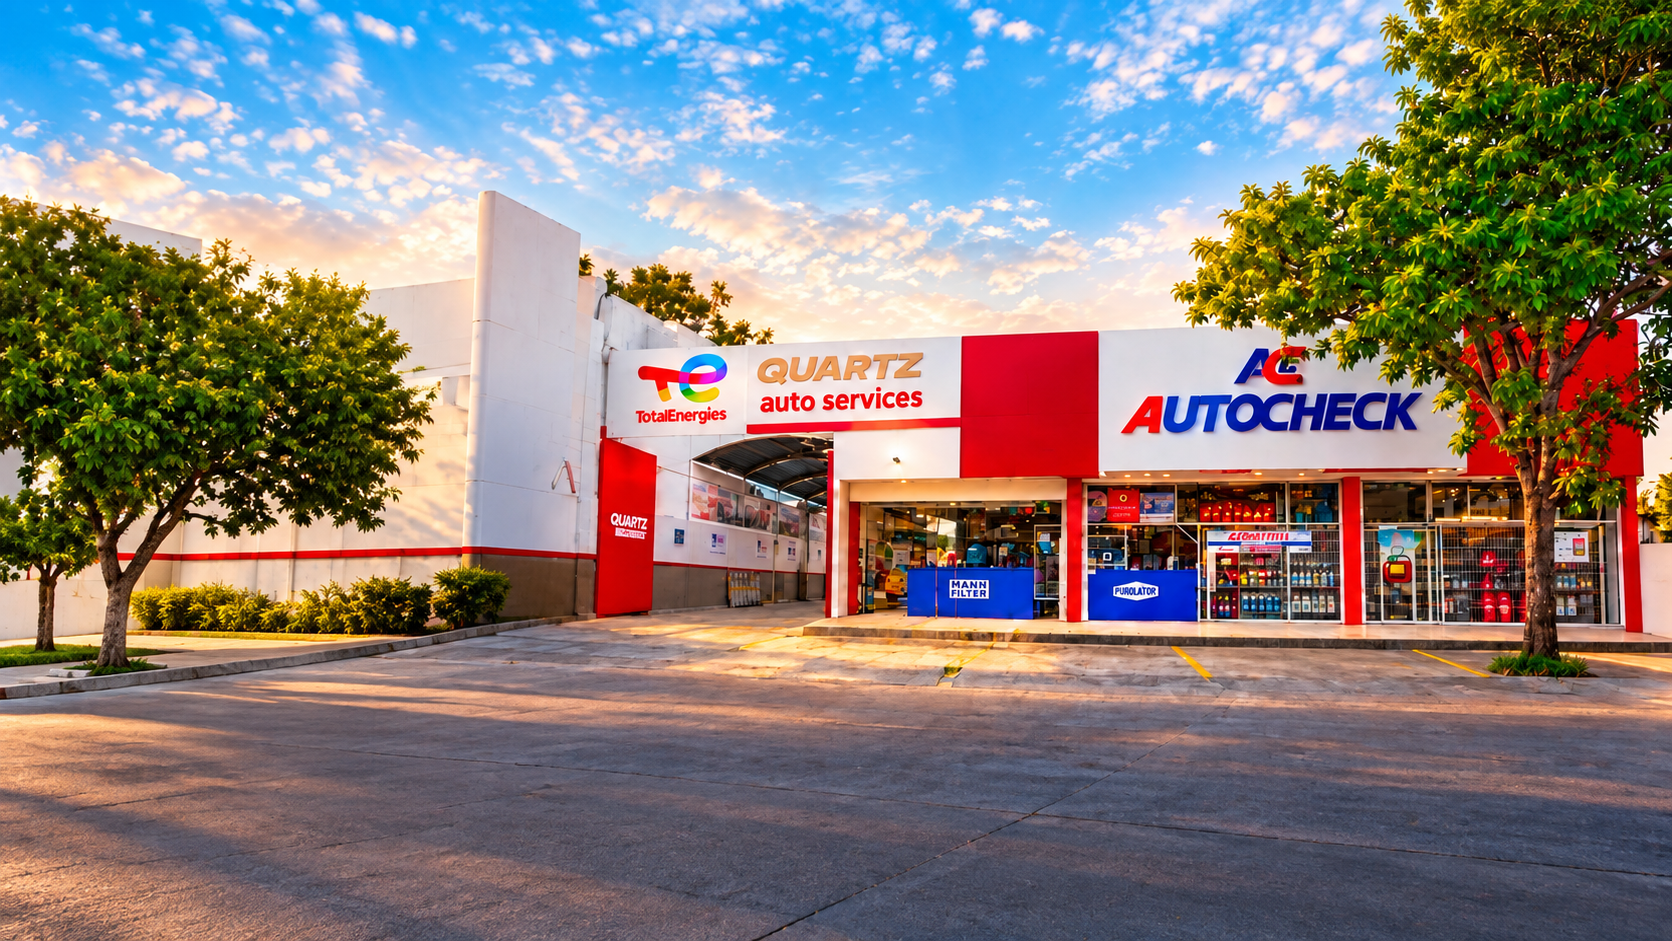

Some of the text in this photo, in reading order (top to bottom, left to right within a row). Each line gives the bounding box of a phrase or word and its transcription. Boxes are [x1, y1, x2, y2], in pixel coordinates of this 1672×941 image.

[757, 353, 923, 385] QUARTZ
[760, 386, 923, 413] auto services
[636, 407, 727, 424] TotalEnergies
[1121, 392, 1422, 434] AUTOCHECK
[611, 512, 648, 530] QUARTZ
[951, 580, 987, 589] MANN
[1115, 586, 1157, 596] PUROLATOR
[951, 589, 987, 598] FILTER
